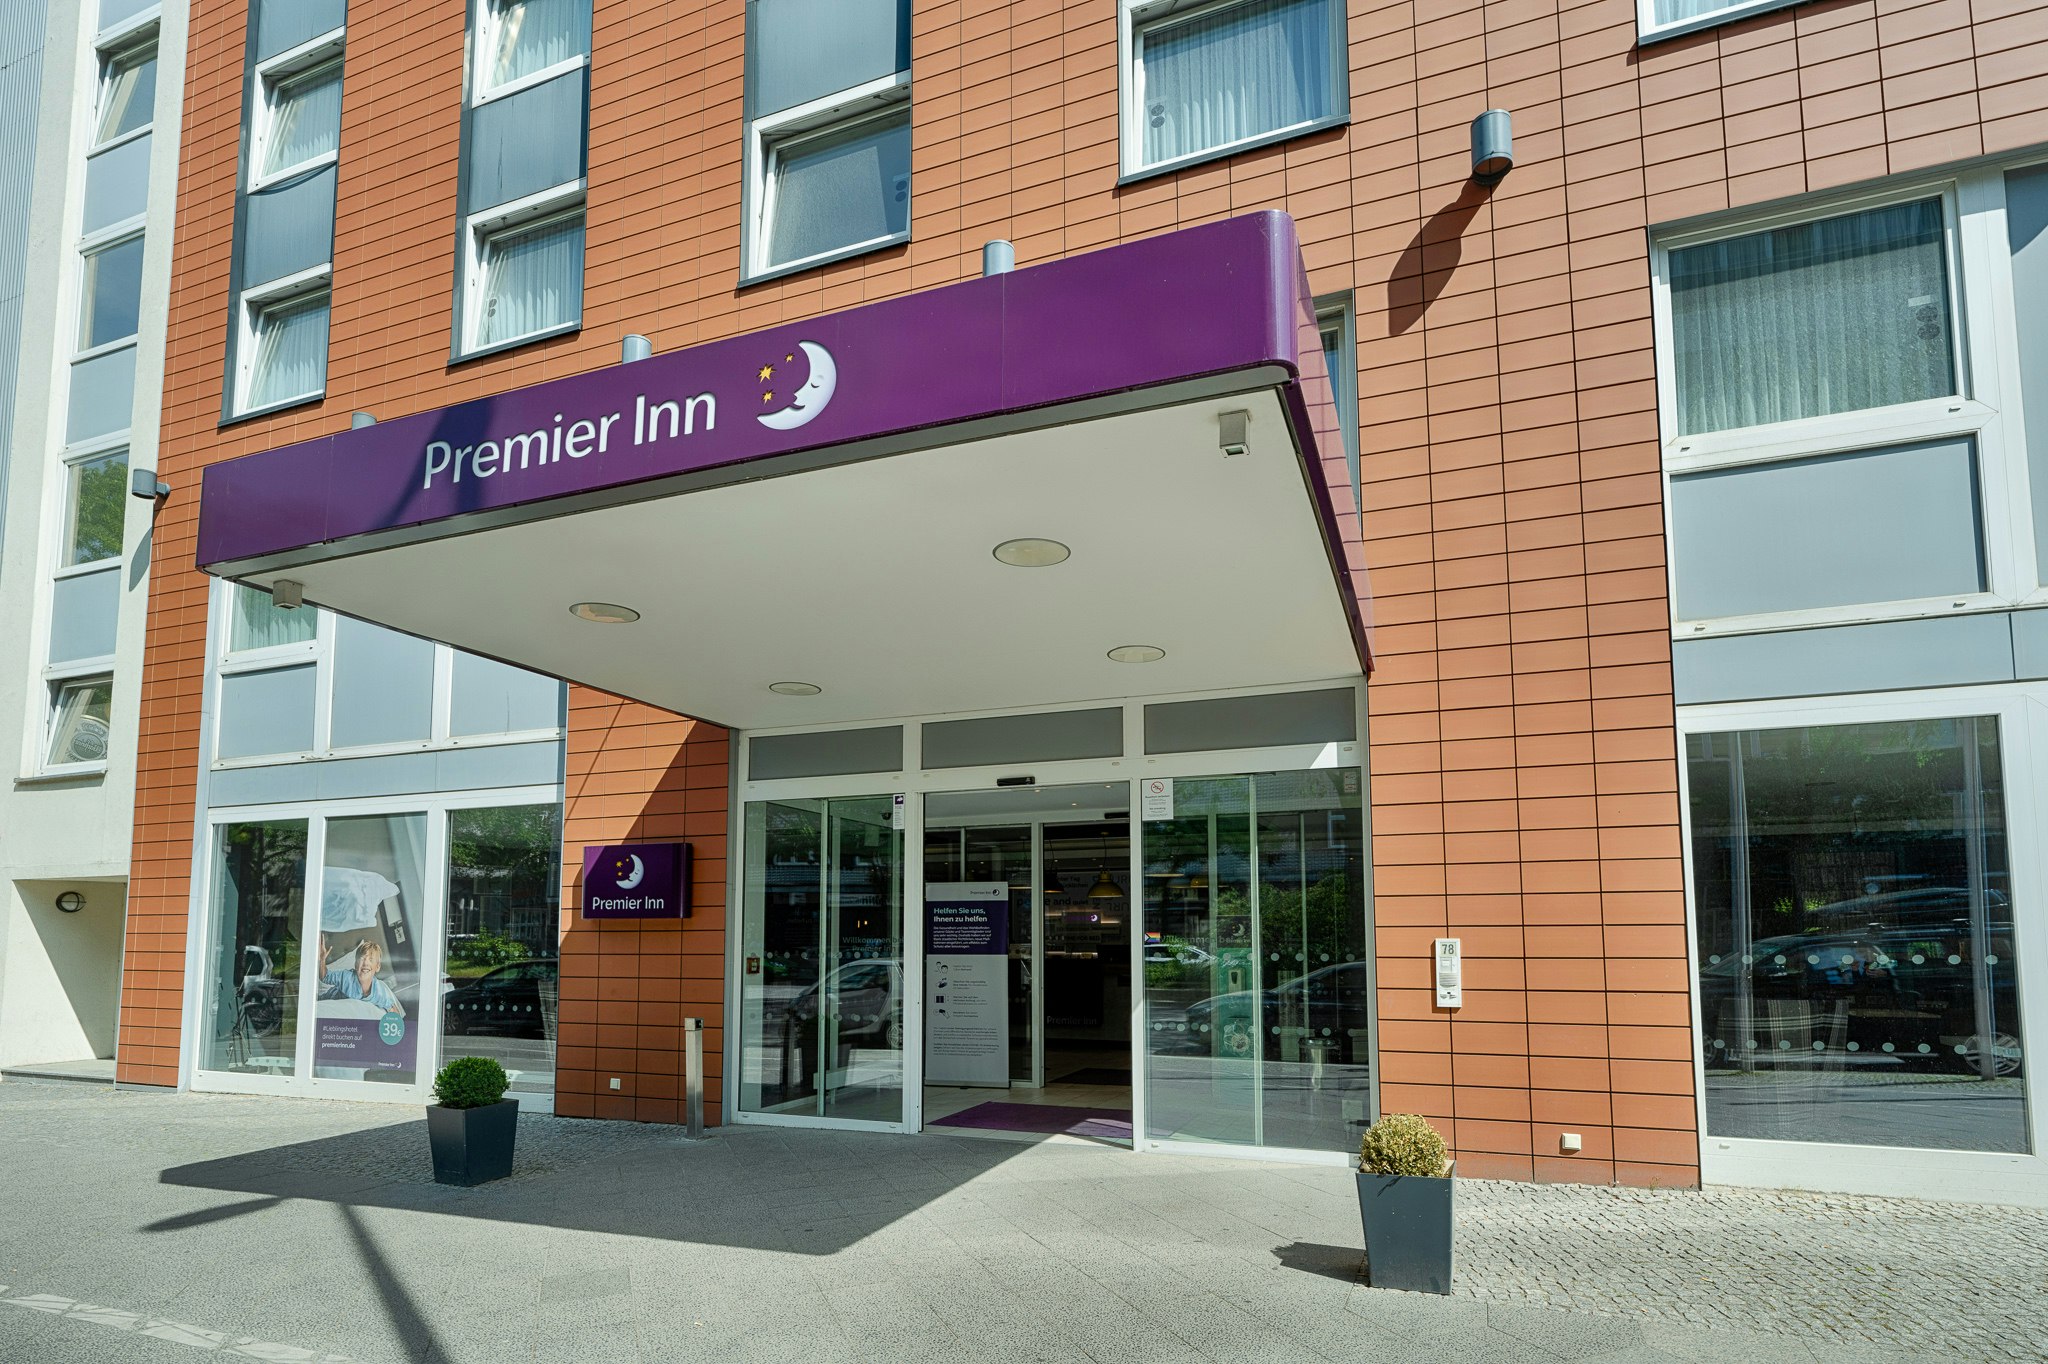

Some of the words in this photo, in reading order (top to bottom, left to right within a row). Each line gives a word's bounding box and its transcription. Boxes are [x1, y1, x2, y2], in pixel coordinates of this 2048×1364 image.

[423, 411, 620, 489] Premier
[634, 390, 717, 445] Inn
[592, 896, 642, 910] Premier
[645, 896, 664, 909] Inn
[1053, 896, 1071, 905] and
[970, 907, 986, 915] uns,
[842, 936, 891, 944] Willkommen
[1442, 943, 1454, 955] 78
[322, 1025, 358, 1034] #Lieblingshotel
[382, 1023, 402, 1037] 39€
